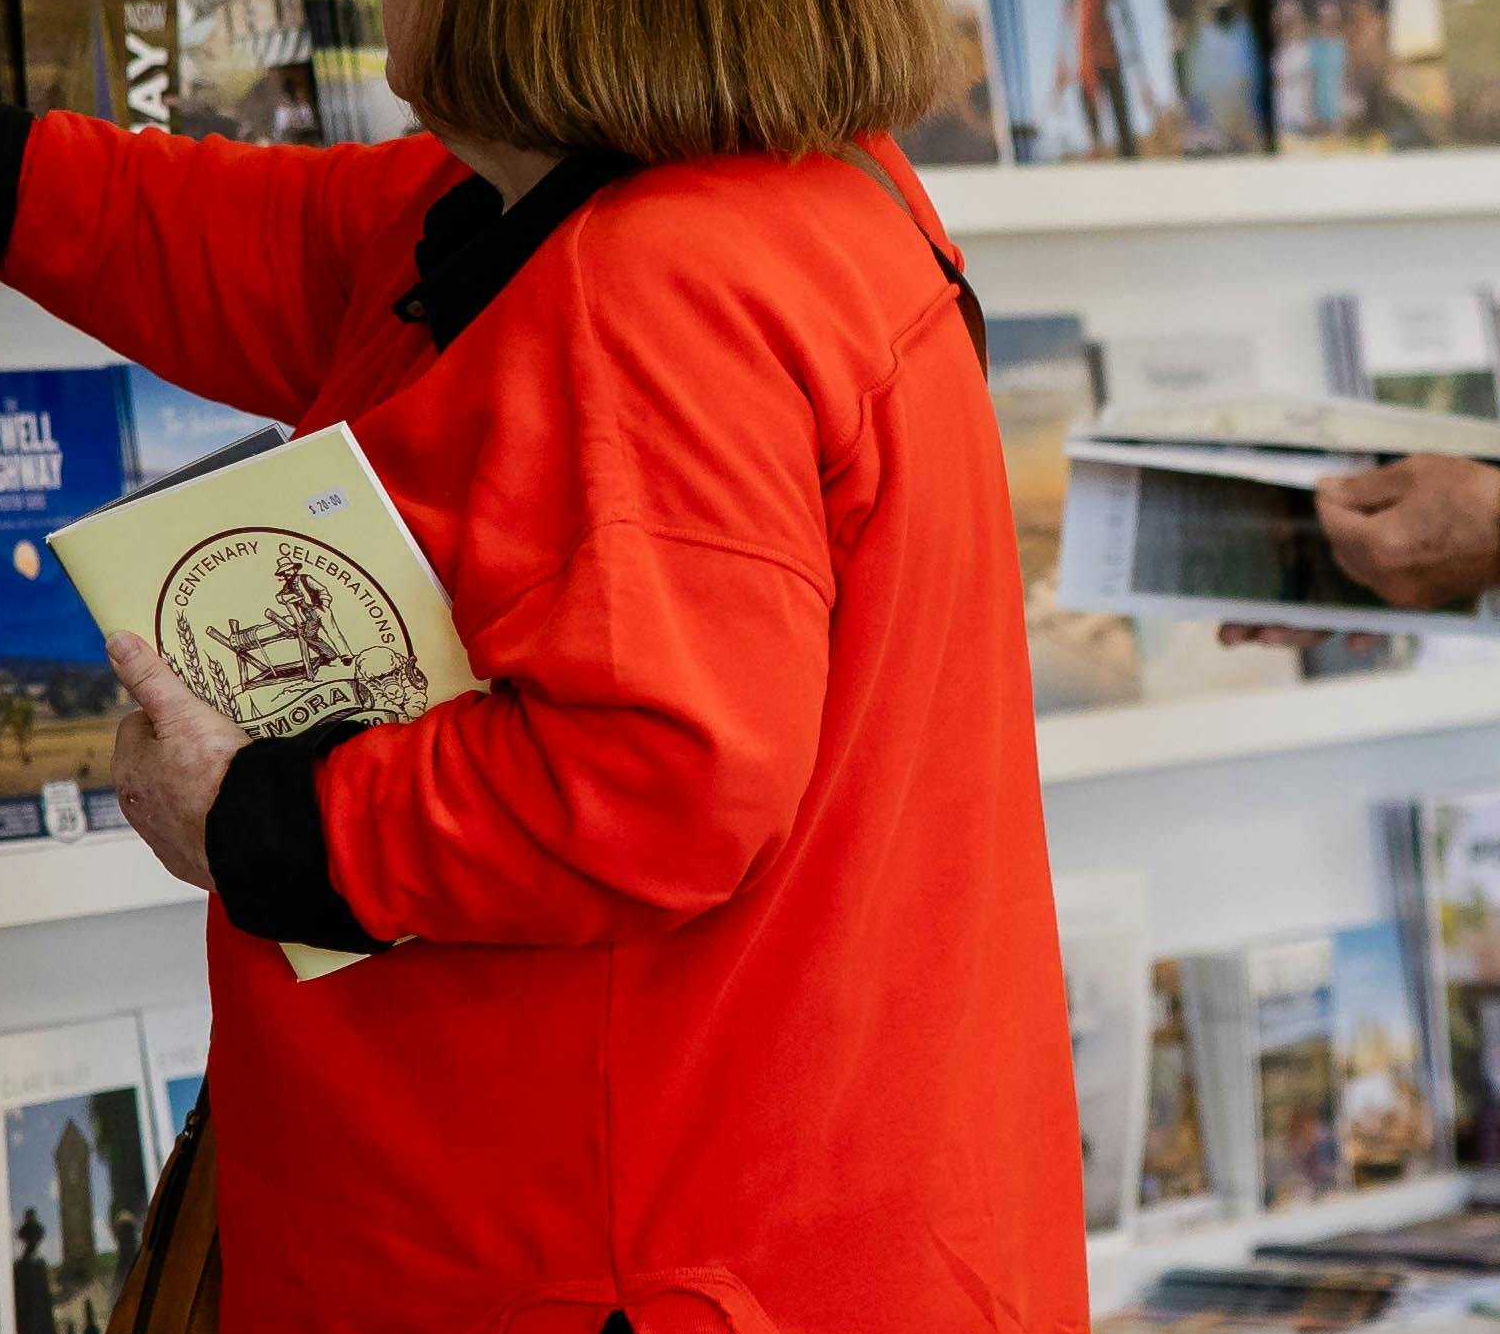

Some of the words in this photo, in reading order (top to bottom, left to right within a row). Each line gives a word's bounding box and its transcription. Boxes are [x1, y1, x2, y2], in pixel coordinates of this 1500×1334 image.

[126, 32, 171, 135] AY
[174, 540, 259, 607] CENTENARY
[278, 542, 396, 644] CELEBRATIONS
[244, 686, 351, 740] EMORA
